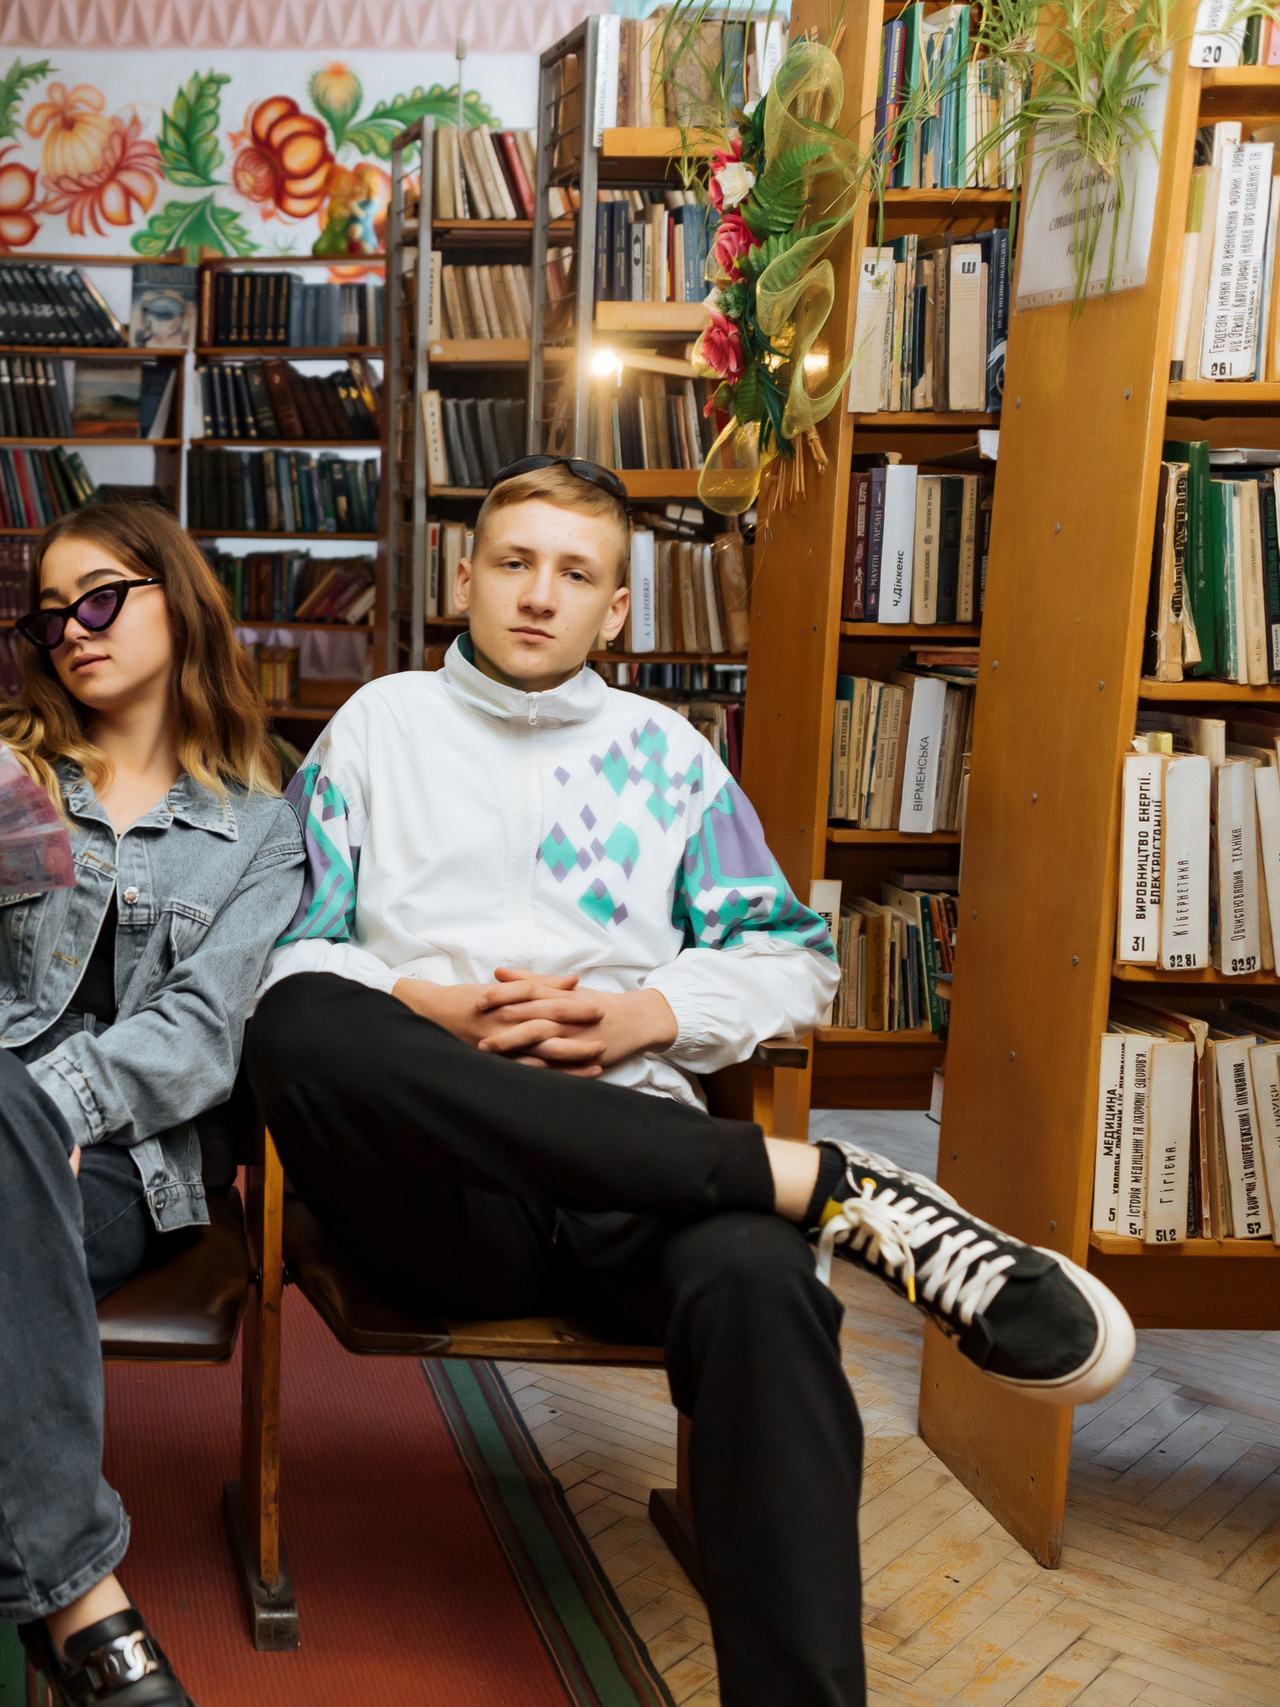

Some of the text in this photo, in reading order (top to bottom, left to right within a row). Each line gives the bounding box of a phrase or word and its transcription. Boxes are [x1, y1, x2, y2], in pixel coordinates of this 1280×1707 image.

[1202, 46, 1221, 64] 20
[864, 264, 877, 276] Ч
[962, 261, 977, 275] Ш
[873, 510, 882, 543] ТАРЗАН
[892, 550, 904, 607] Ч.Діккенс
[913, 735, 930, 812] ВІРМЕНСЬКА
[1135, 772, 1151, 920] ВИРОБНИЦТВО ЕНЕРГІЇ.
[1132, 936, 1145, 952] 31
[1169, 953, 1196, 968] 32.81
[1231, 956, 1257, 972] 32.97
[1103, 1084, 1117, 1157] МЕДИЦИНА.
[1246, 1221, 1262, 1235] 57
